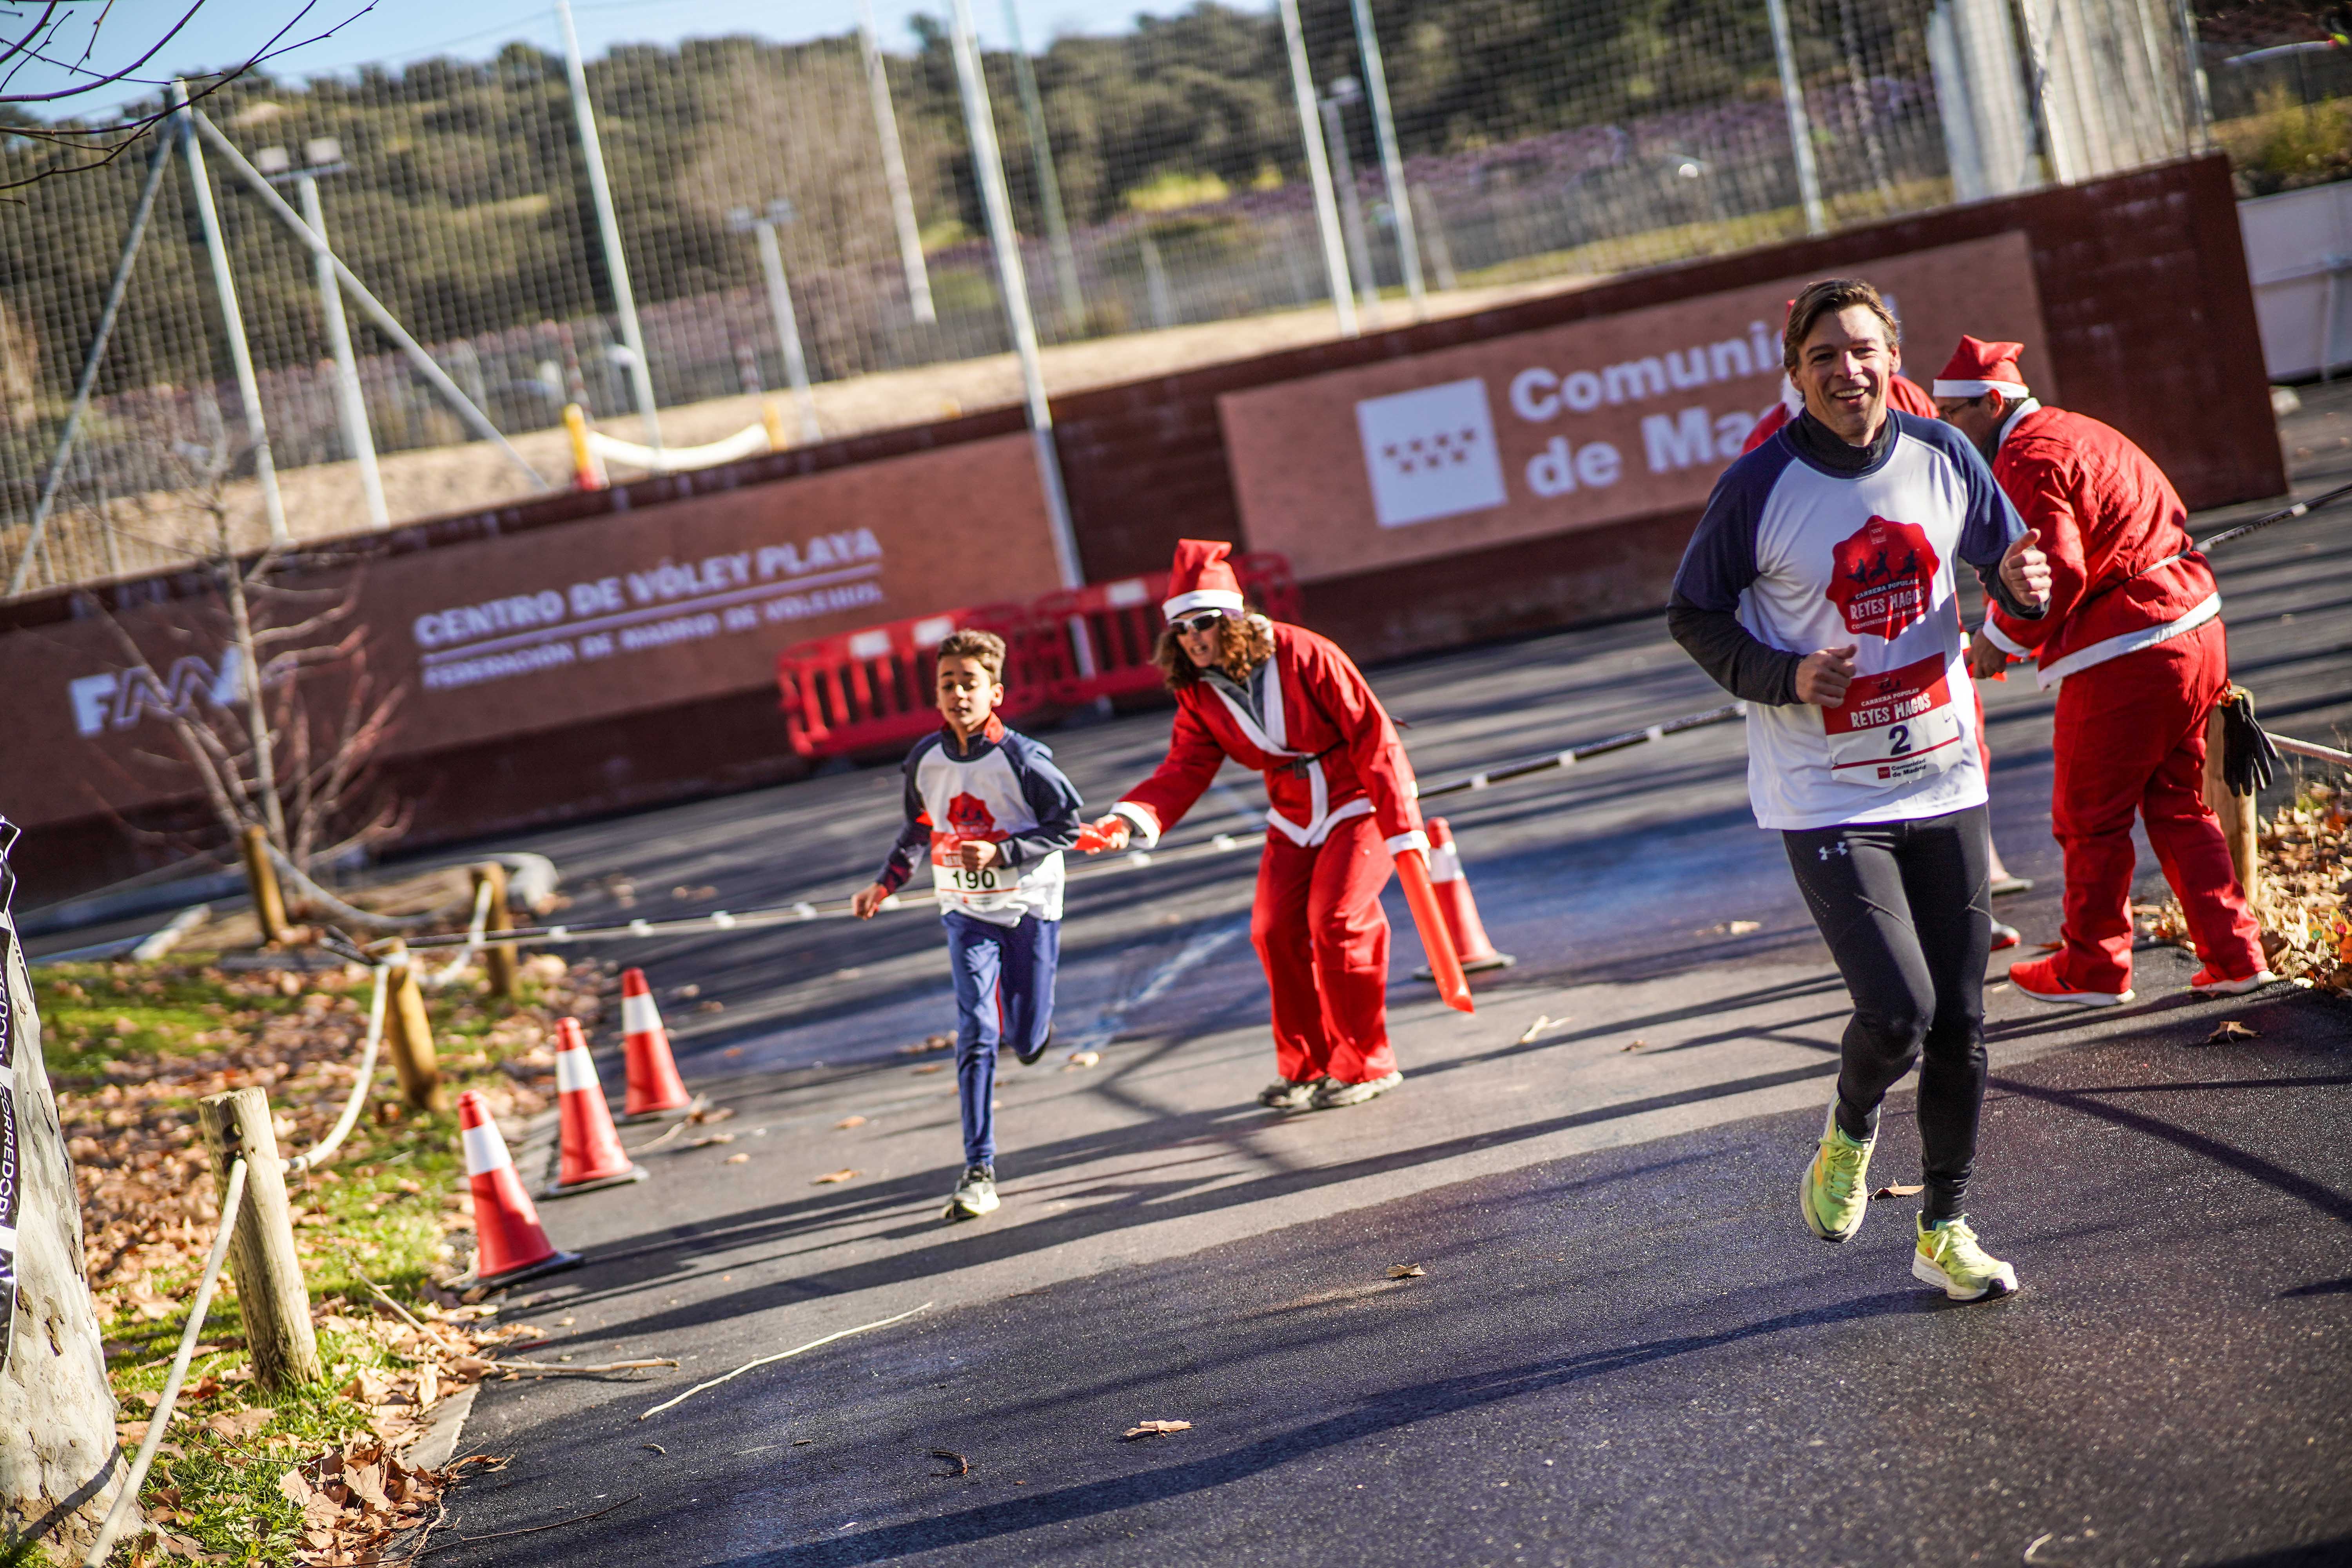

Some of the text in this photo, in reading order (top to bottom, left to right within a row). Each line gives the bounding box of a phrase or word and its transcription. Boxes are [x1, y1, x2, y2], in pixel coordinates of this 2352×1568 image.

[1524, 405, 1775, 498] de Ma
[414, 589, 565, 649] CENTRO
[568, 576, 626, 617] DE
[756, 527, 884, 579] PLAYA
[1849, 586, 1924, 620] REYES MAGOS
[1855, 585, 1887, 600] CARRERA
[1850, 692, 1931, 728] REYES MAGOS
[1888, 725, 1911, 756] 2
[952, 869, 995, 889] 190
